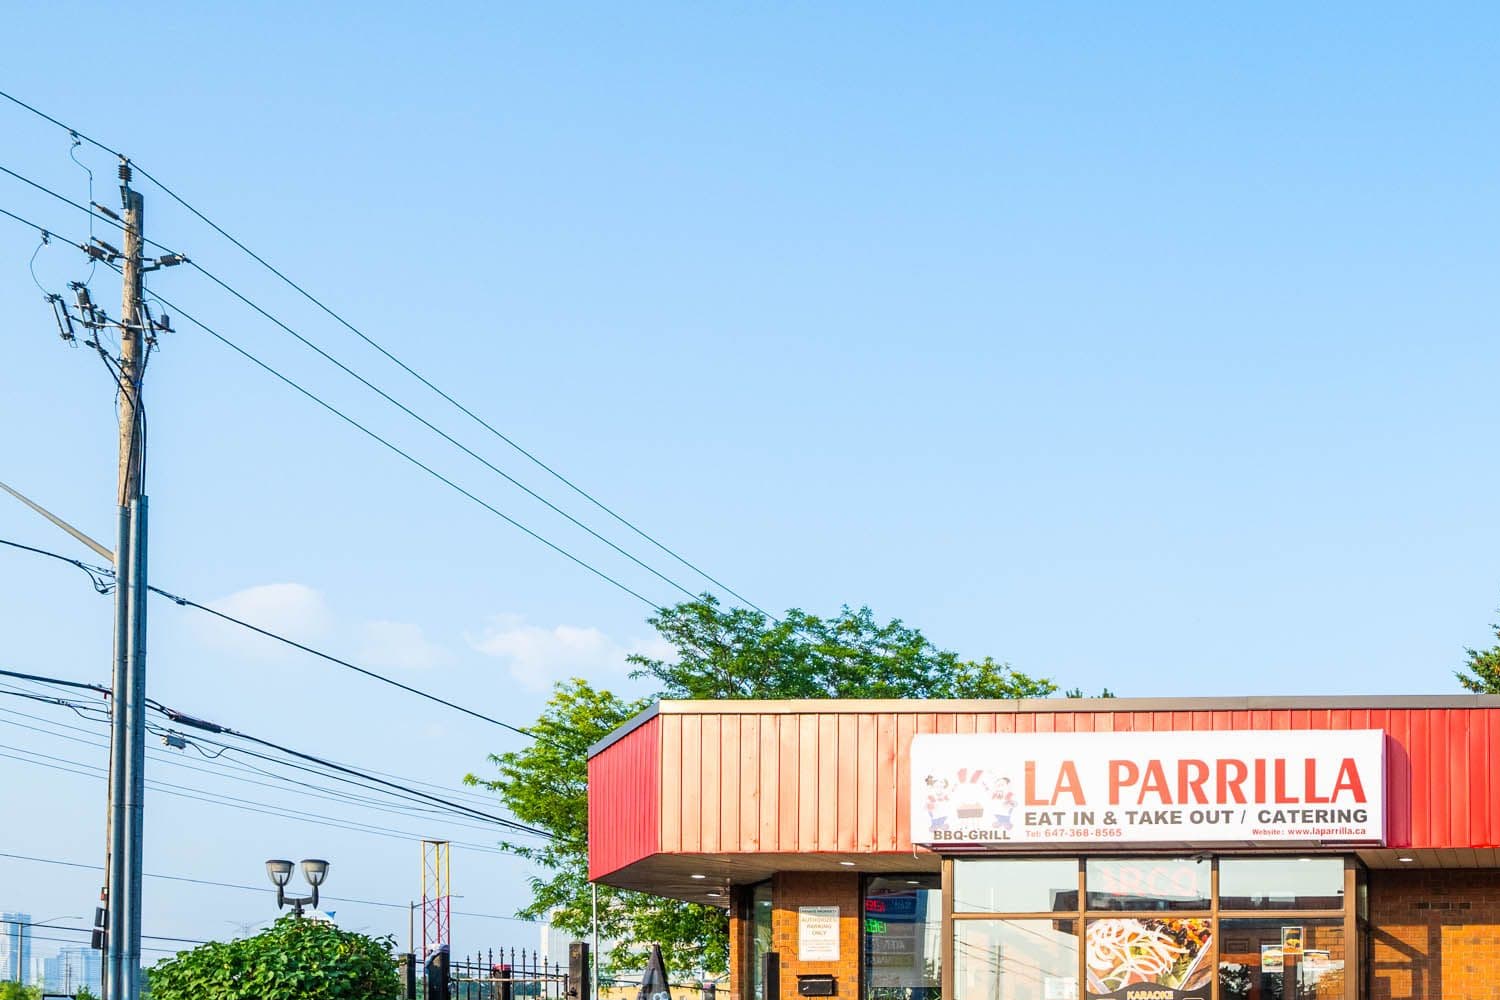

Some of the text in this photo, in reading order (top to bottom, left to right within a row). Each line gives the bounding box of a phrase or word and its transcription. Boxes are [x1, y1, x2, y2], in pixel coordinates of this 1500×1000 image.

[1024, 757, 1368, 807] LA PARRILLA
[1024, 811, 1066, 826] EAT
[1073, 811, 1096, 826] IN
[1102, 811, 1118, 825] &
[1125, 810, 1182, 825] TAKE
[1189, 809, 1234, 825] OUT
[1257, 809, 1368, 824] CATERING
[933, 830, 1011, 841] BBQ-GRILL
[1044, 828, 1122, 838] 647-368-8565
[1287, 826, 1366, 837] www.laparrilla.ca
[1126, 990, 1174, 1000] KARAOKE
